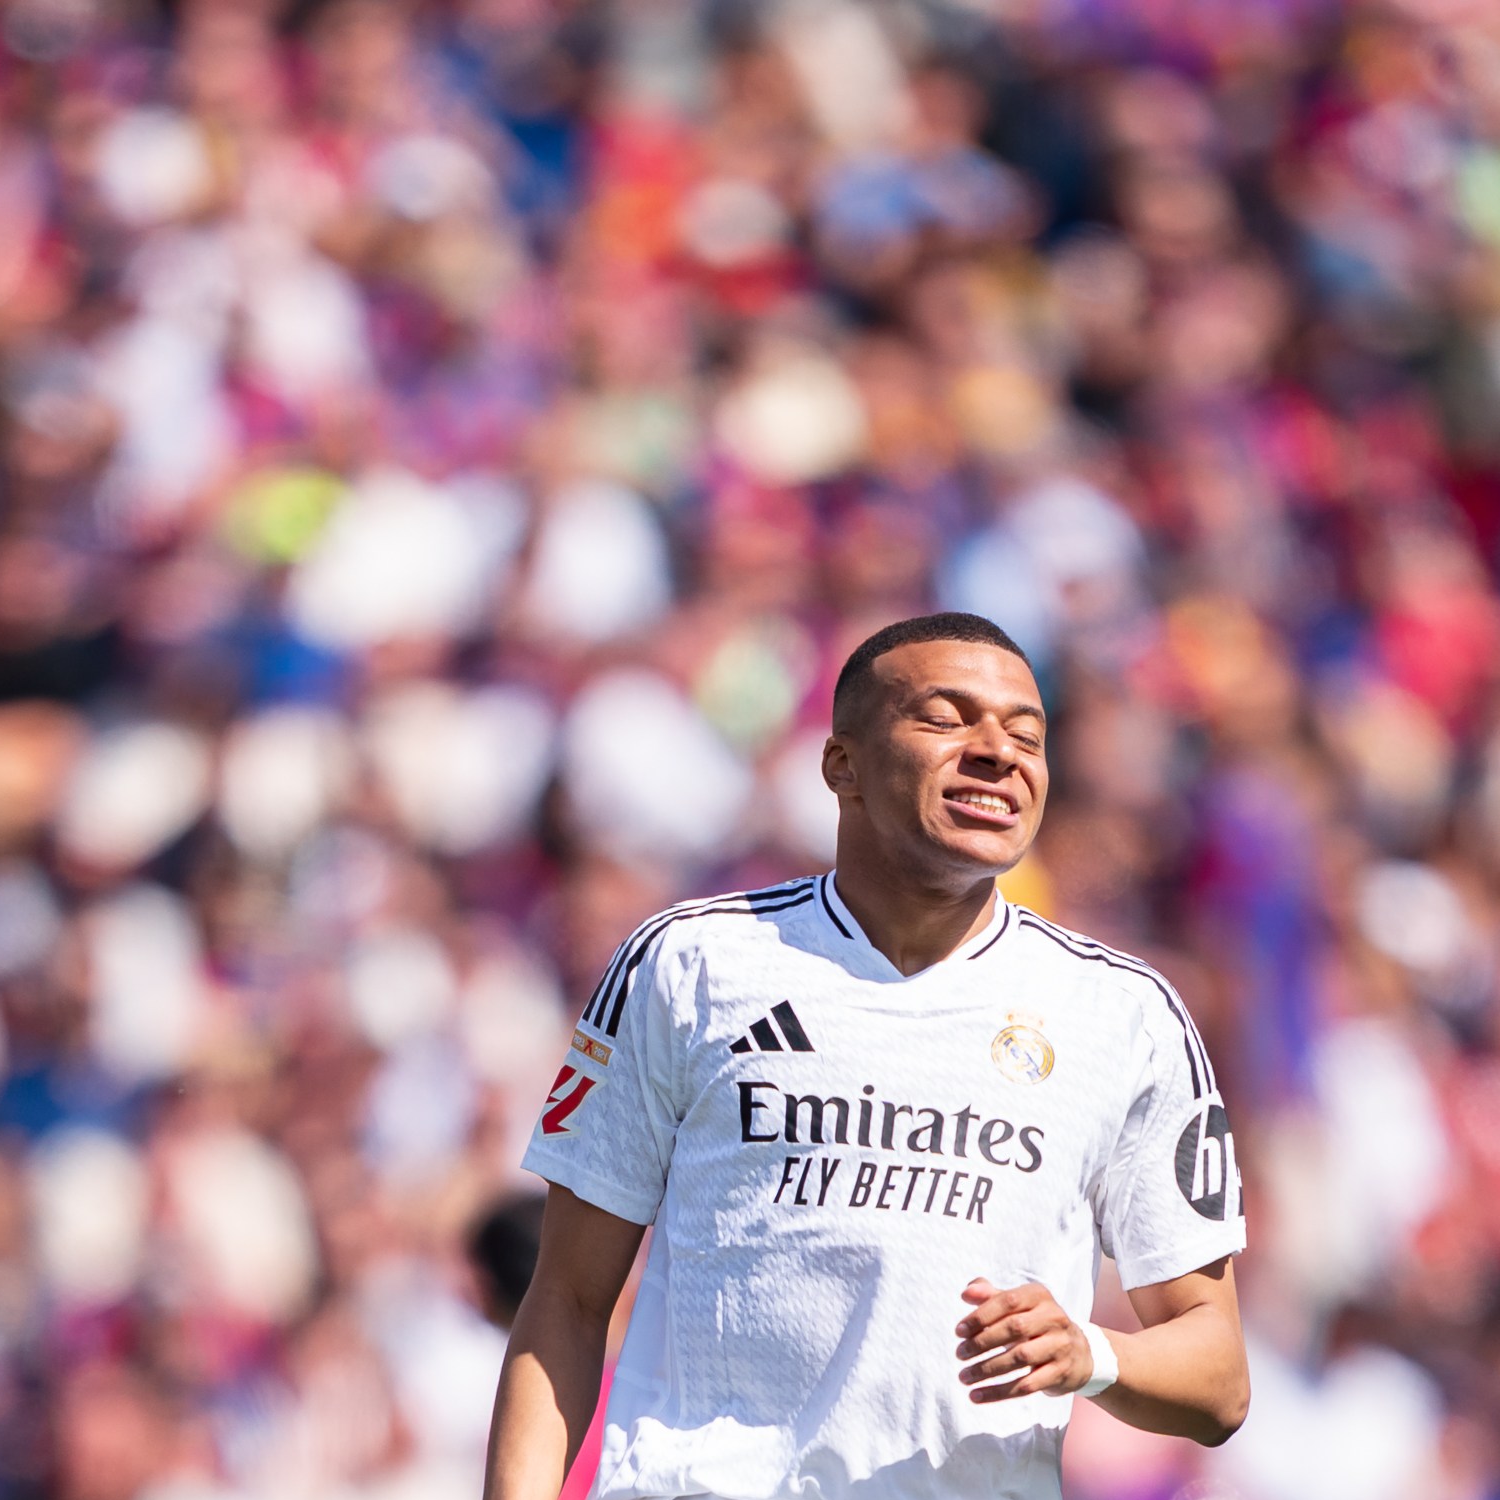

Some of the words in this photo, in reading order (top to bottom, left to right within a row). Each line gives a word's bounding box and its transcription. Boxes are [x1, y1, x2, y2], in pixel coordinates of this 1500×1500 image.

[736, 1081, 1045, 1173] Emirates
[773, 1157, 841, 1206] FLY
[848, 1161, 993, 1224] BETTER
